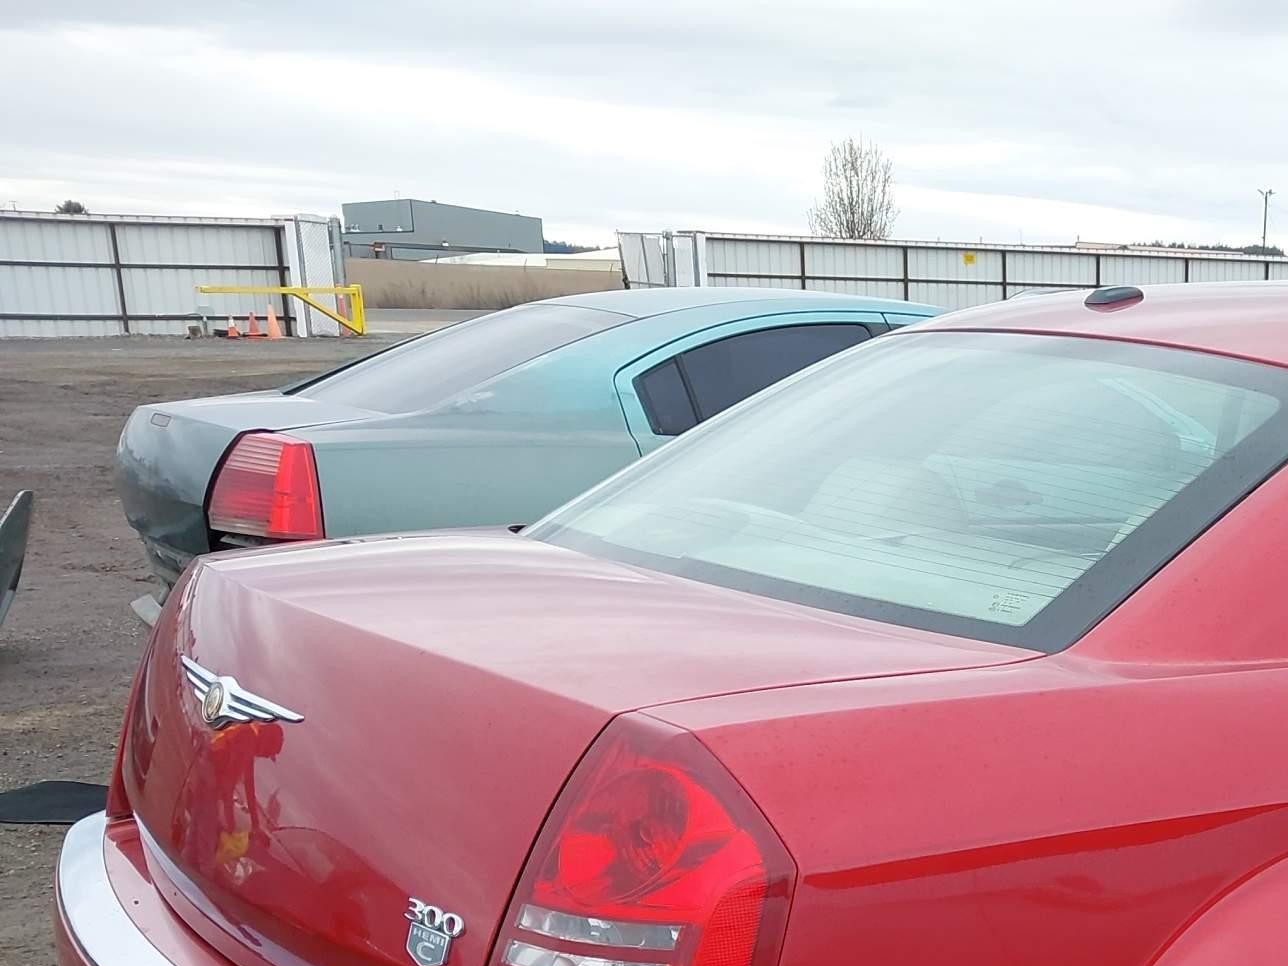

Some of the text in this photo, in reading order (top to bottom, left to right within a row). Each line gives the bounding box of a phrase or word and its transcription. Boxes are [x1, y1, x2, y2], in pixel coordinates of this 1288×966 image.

[404, 897, 464, 937] 300
[413, 928, 444, 946] HEMI
[416, 941, 435, 961] C
